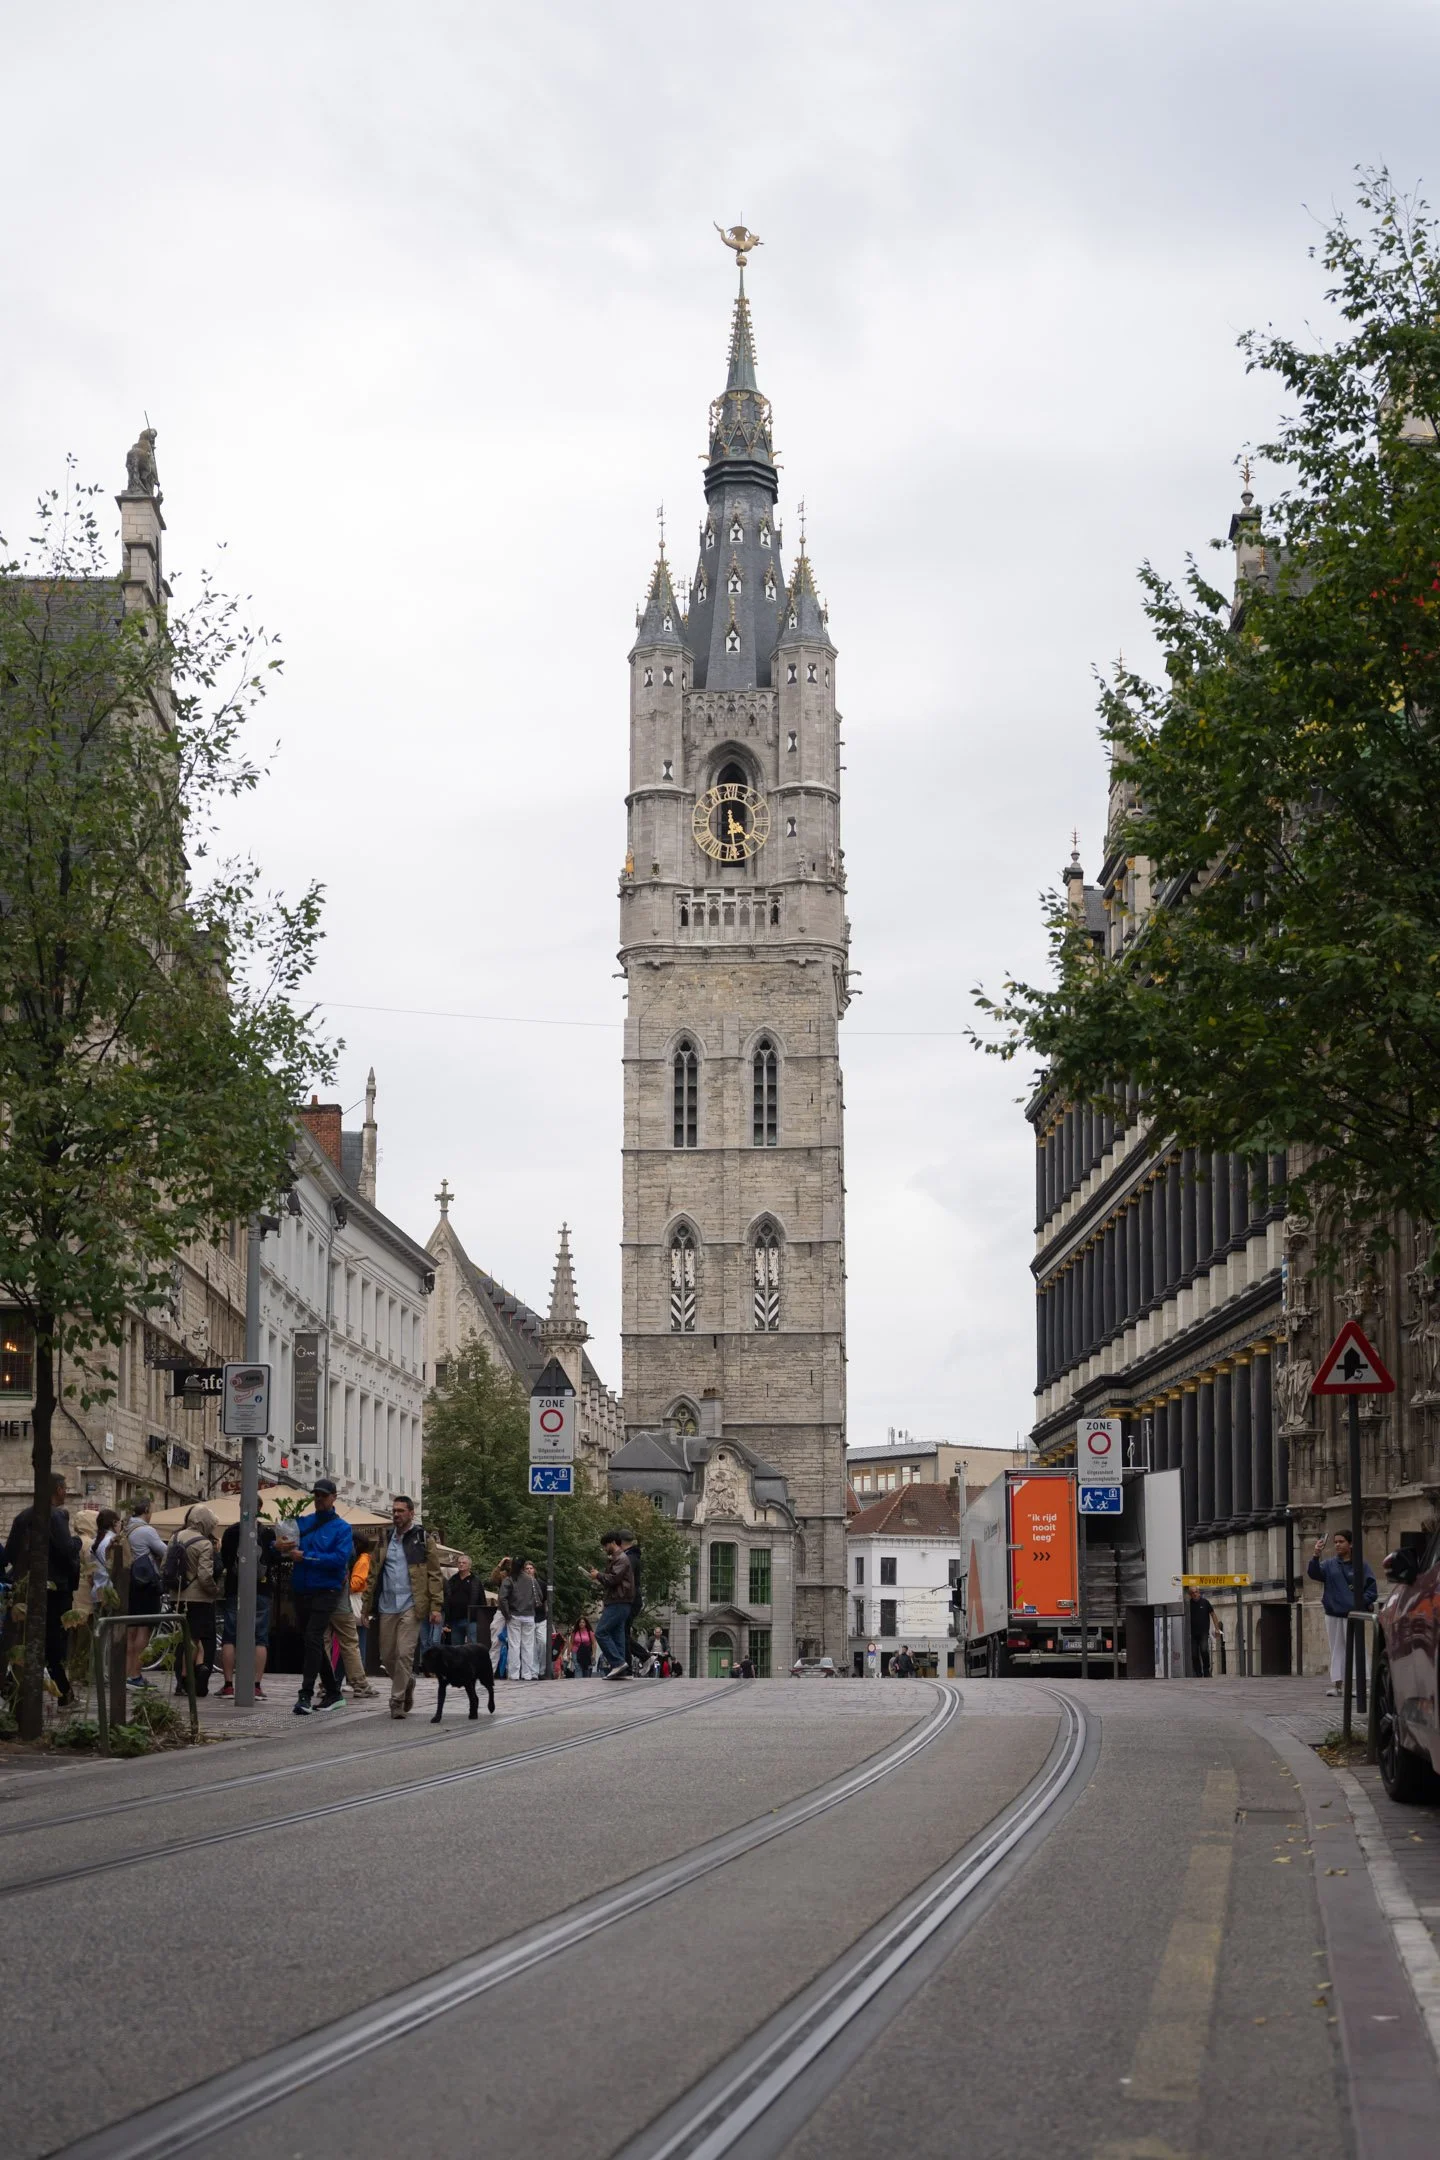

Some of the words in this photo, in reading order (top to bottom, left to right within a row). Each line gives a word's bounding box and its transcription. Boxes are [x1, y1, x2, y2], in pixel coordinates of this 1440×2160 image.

[539, 1399, 565, 1408] ZONE
[1086, 1422, 1112, 1430] ZONE
[1042, 1513, 1057, 1523] rijd
[1032, 1523, 1057, 1532] nooit
[1198, 1575, 1226, 1585] Novotel
